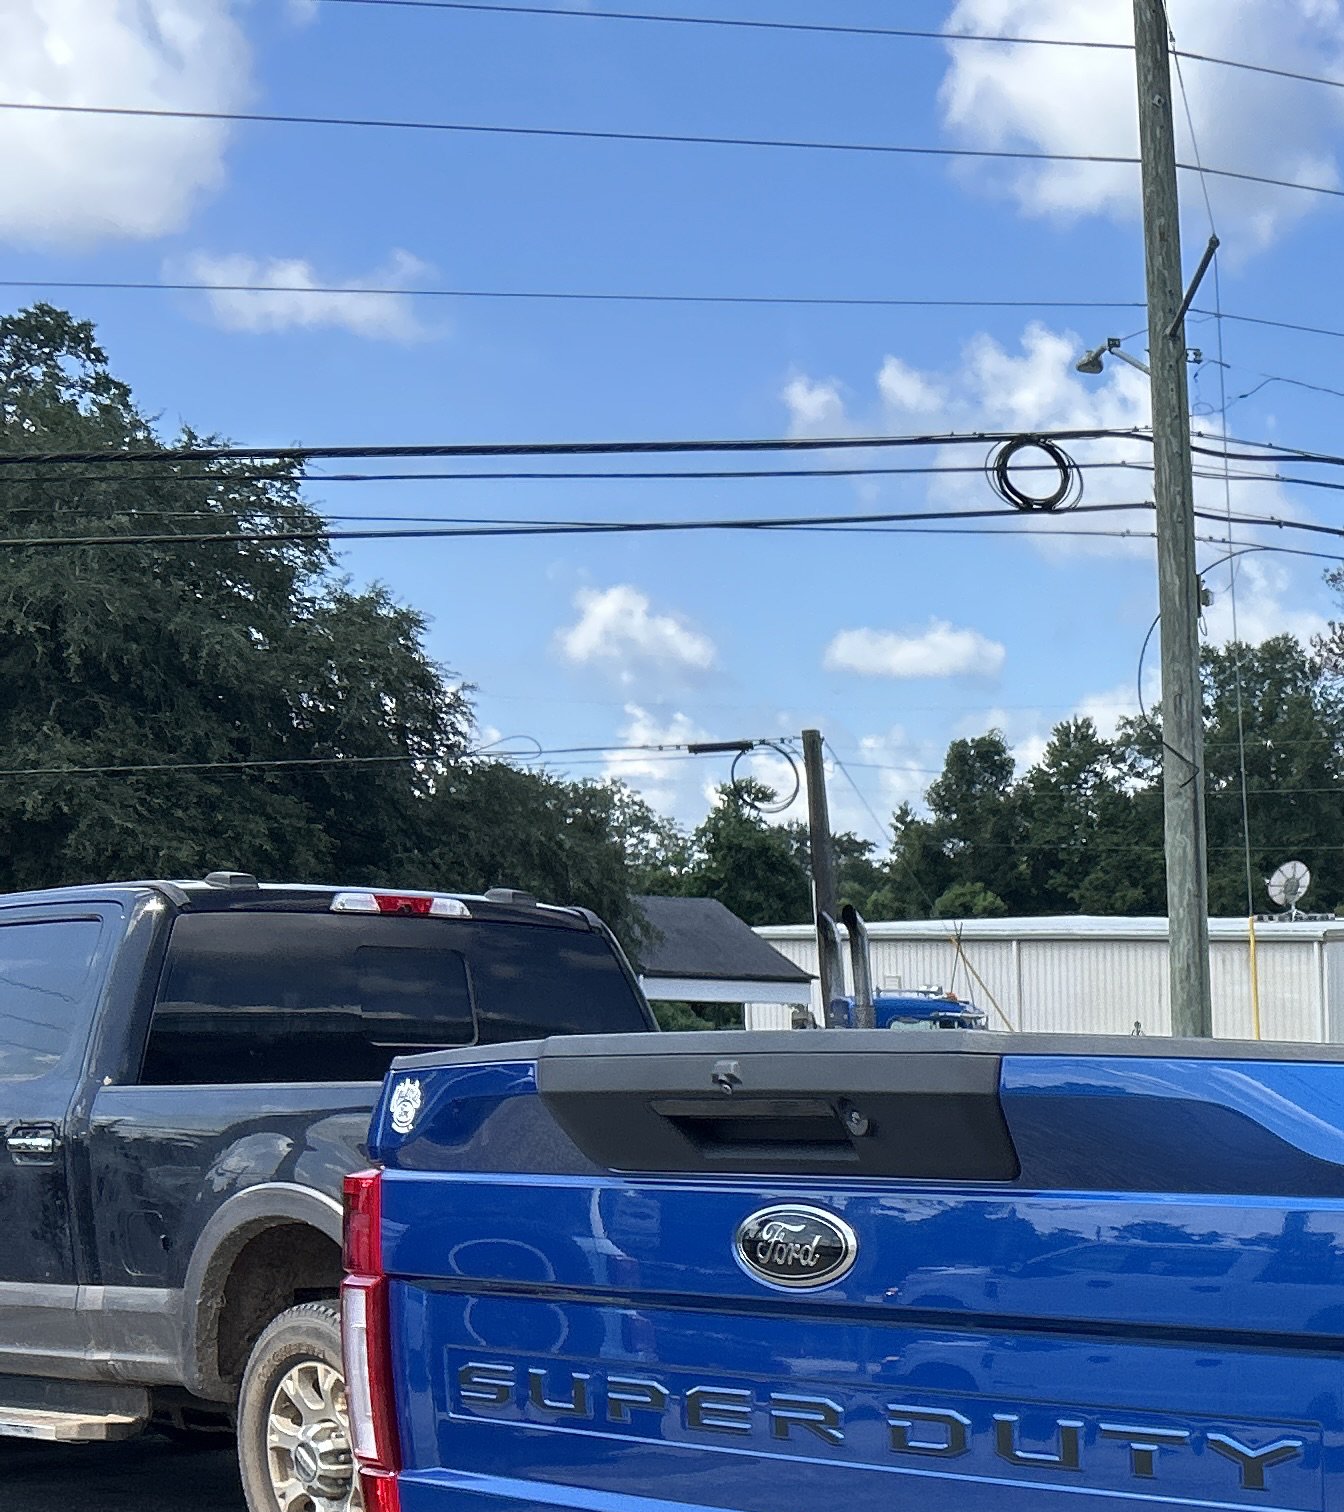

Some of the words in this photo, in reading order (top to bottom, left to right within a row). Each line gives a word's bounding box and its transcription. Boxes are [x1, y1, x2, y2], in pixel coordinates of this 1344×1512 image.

[757, 1221, 822, 1267] Ford
[458, 1361, 849, 1446] SUPER
[887, 1403, 1303, 1491] DUTY
